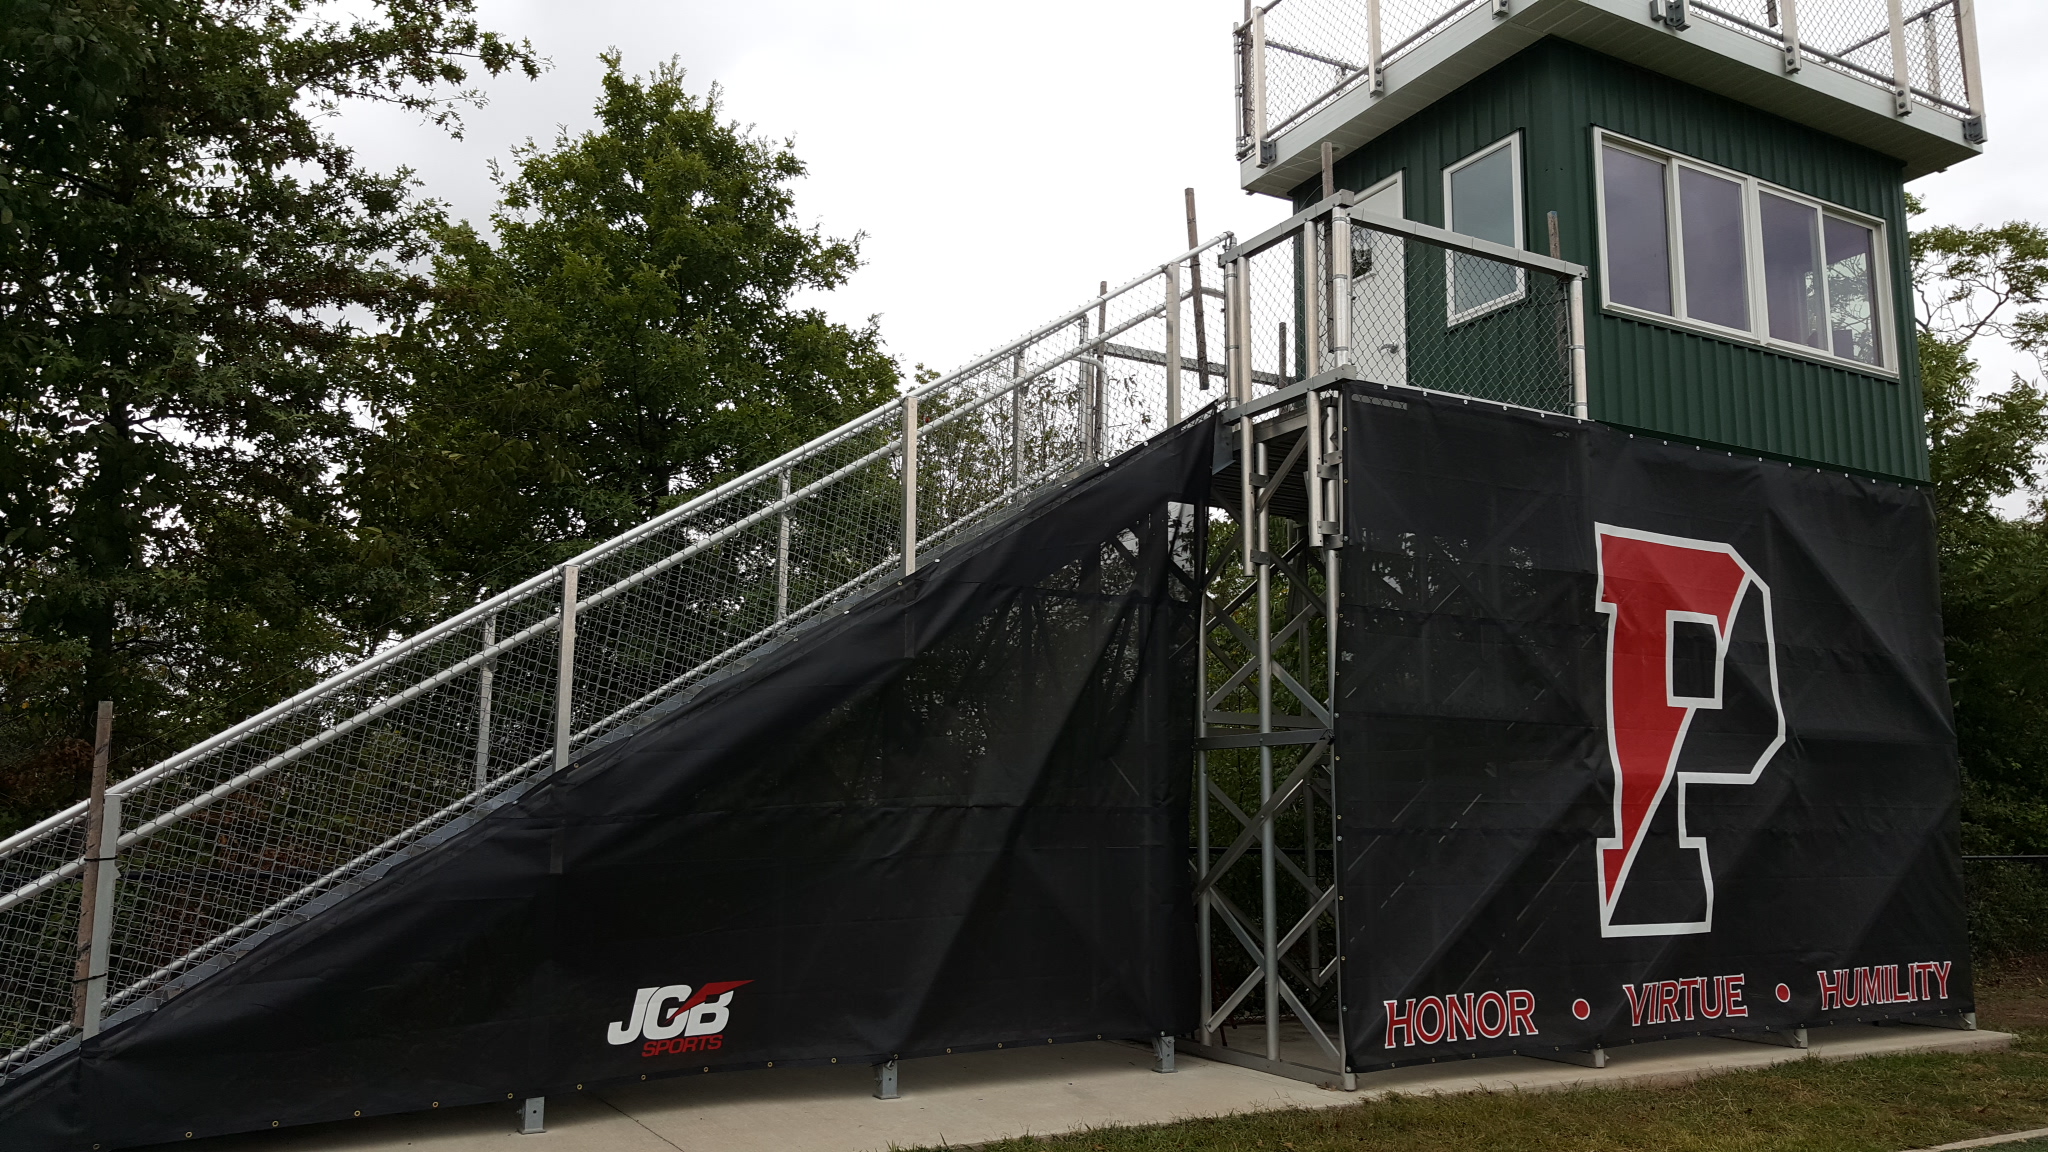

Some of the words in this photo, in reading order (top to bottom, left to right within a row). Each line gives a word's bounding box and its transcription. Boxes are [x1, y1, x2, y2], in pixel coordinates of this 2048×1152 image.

[1595, 522, 1786, 938] P
[607, 984, 734, 1046] JGB
[1384, 989, 1539, 1048] HONOR
[1623, 974, 1748, 1026] VIRTUE
[1817, 961, 1952, 1010] HUMILITY
[641, 1034, 724, 1058] SPORTS
